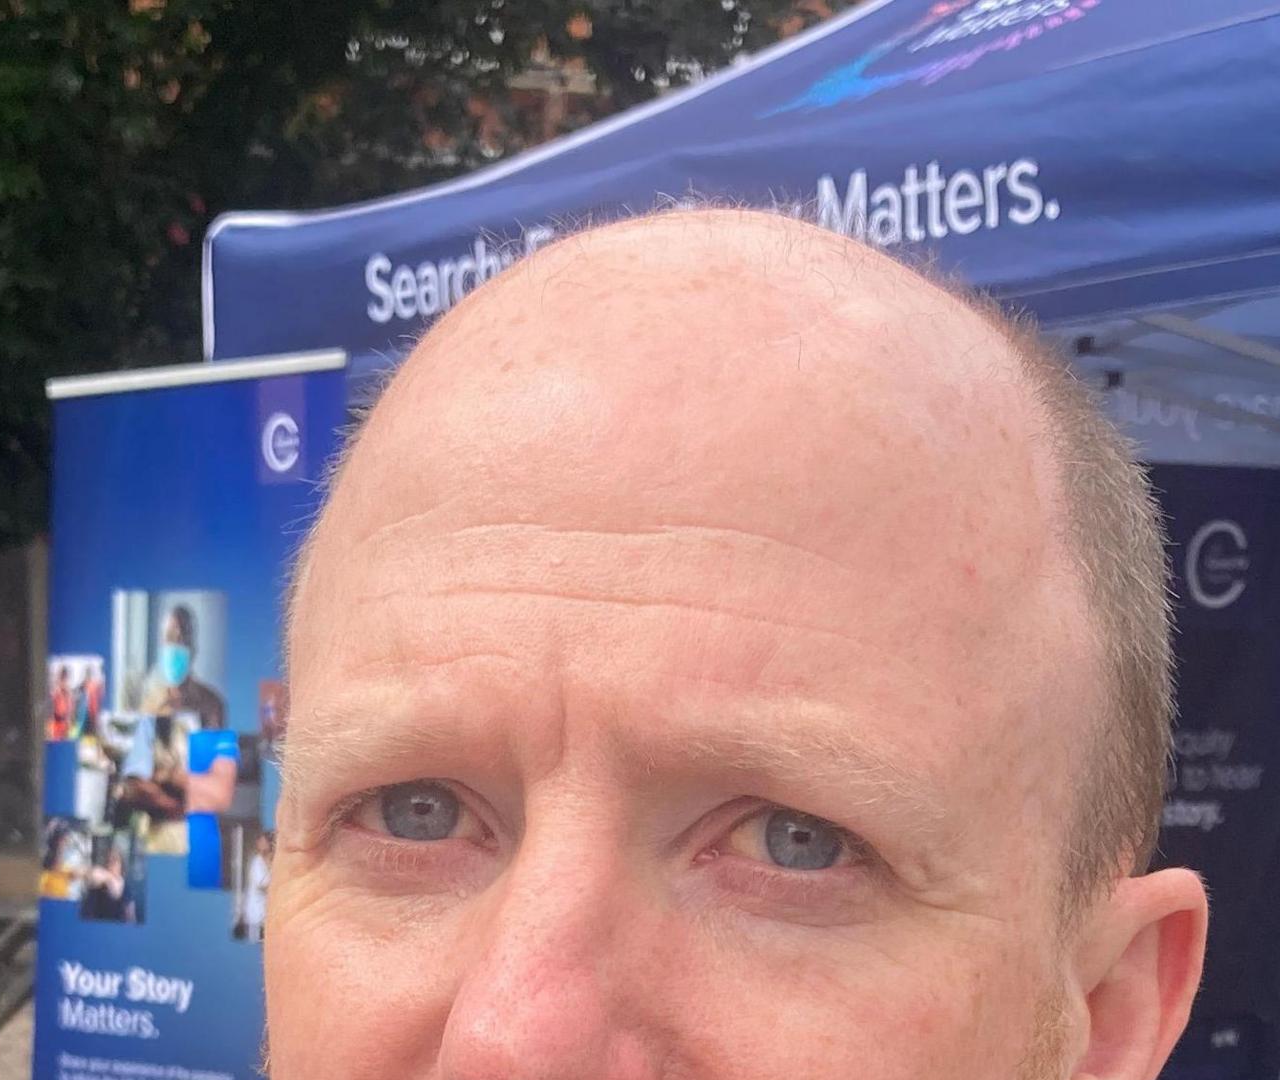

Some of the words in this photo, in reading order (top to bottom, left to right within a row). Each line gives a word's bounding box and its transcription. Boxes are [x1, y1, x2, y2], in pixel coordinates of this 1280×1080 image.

[816, 157, 1061, 247] Matters.
[60, 960, 122, 997] Your
[127, 966, 194, 1013] Story
[58, 999, 160, 1039] Matters.
